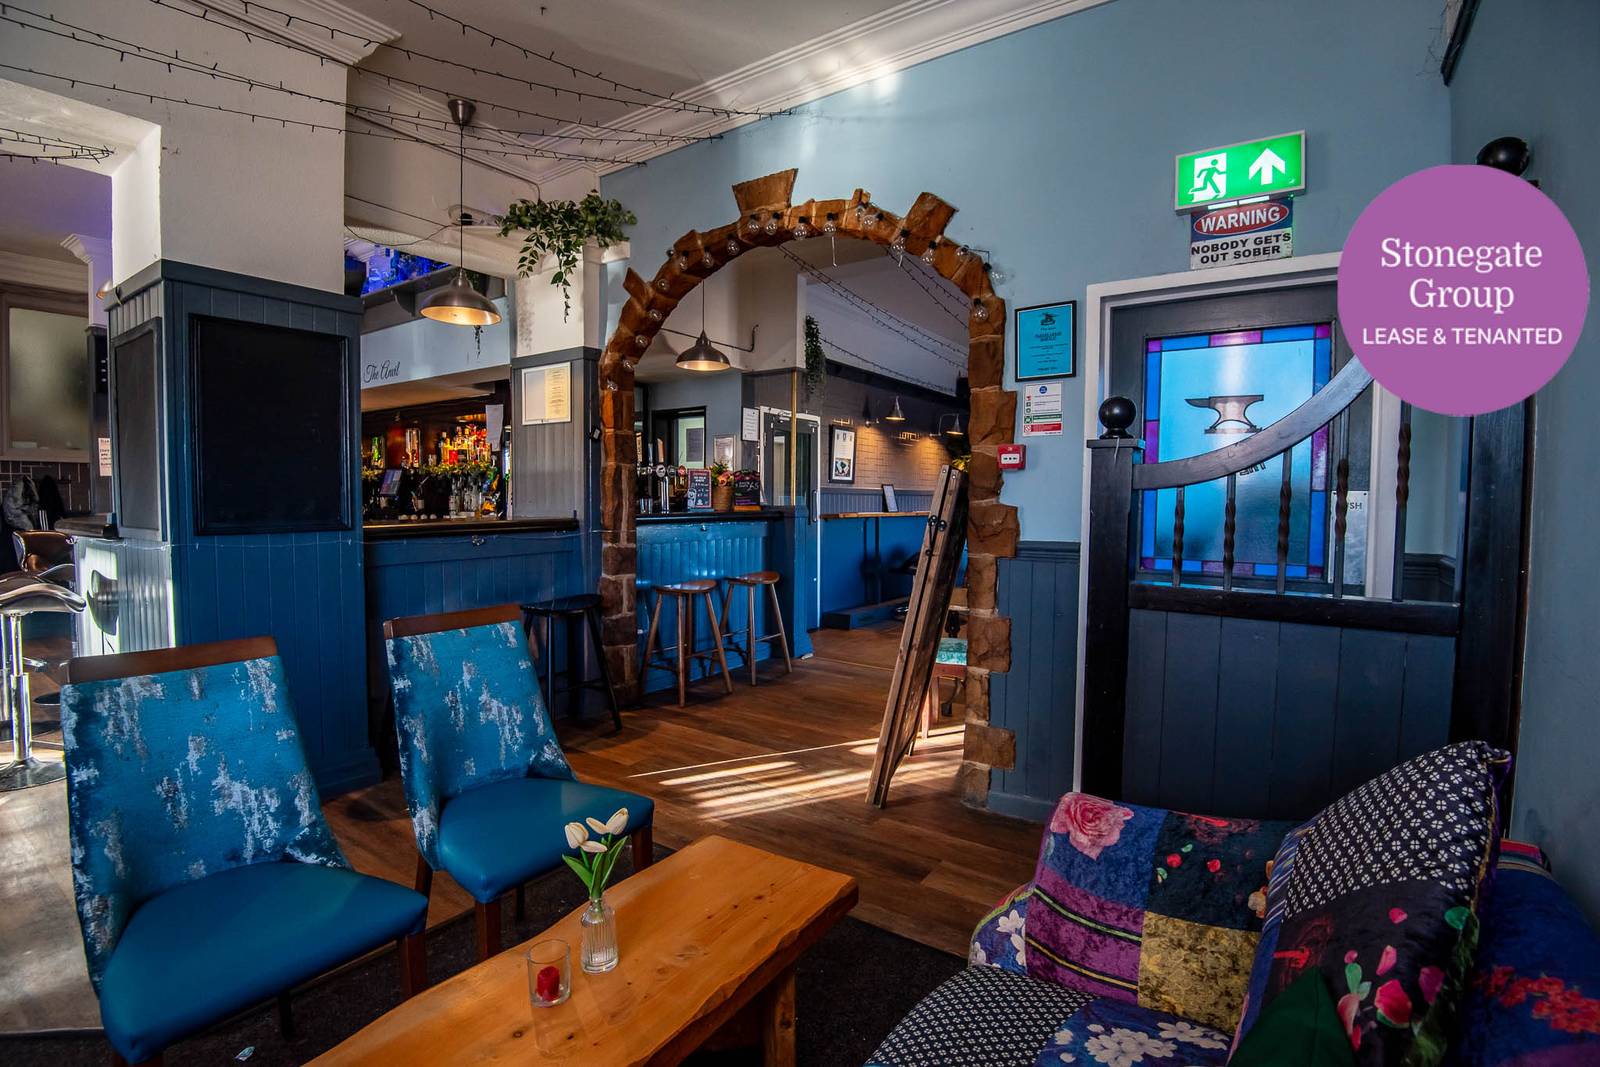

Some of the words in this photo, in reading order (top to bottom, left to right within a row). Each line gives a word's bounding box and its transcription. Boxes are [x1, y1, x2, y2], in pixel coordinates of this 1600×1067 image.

[1200, 206, 1281, 233] WARNING
[1191, 238, 1250, 256] NOBODY
[1253, 232, 1292, 246] GETS
[1200, 252, 1229, 265] OUT
[1233, 245, 1281, 260] SOBER
[364, 364, 379, 383] The
[380, 359, 401, 380] Anvil
